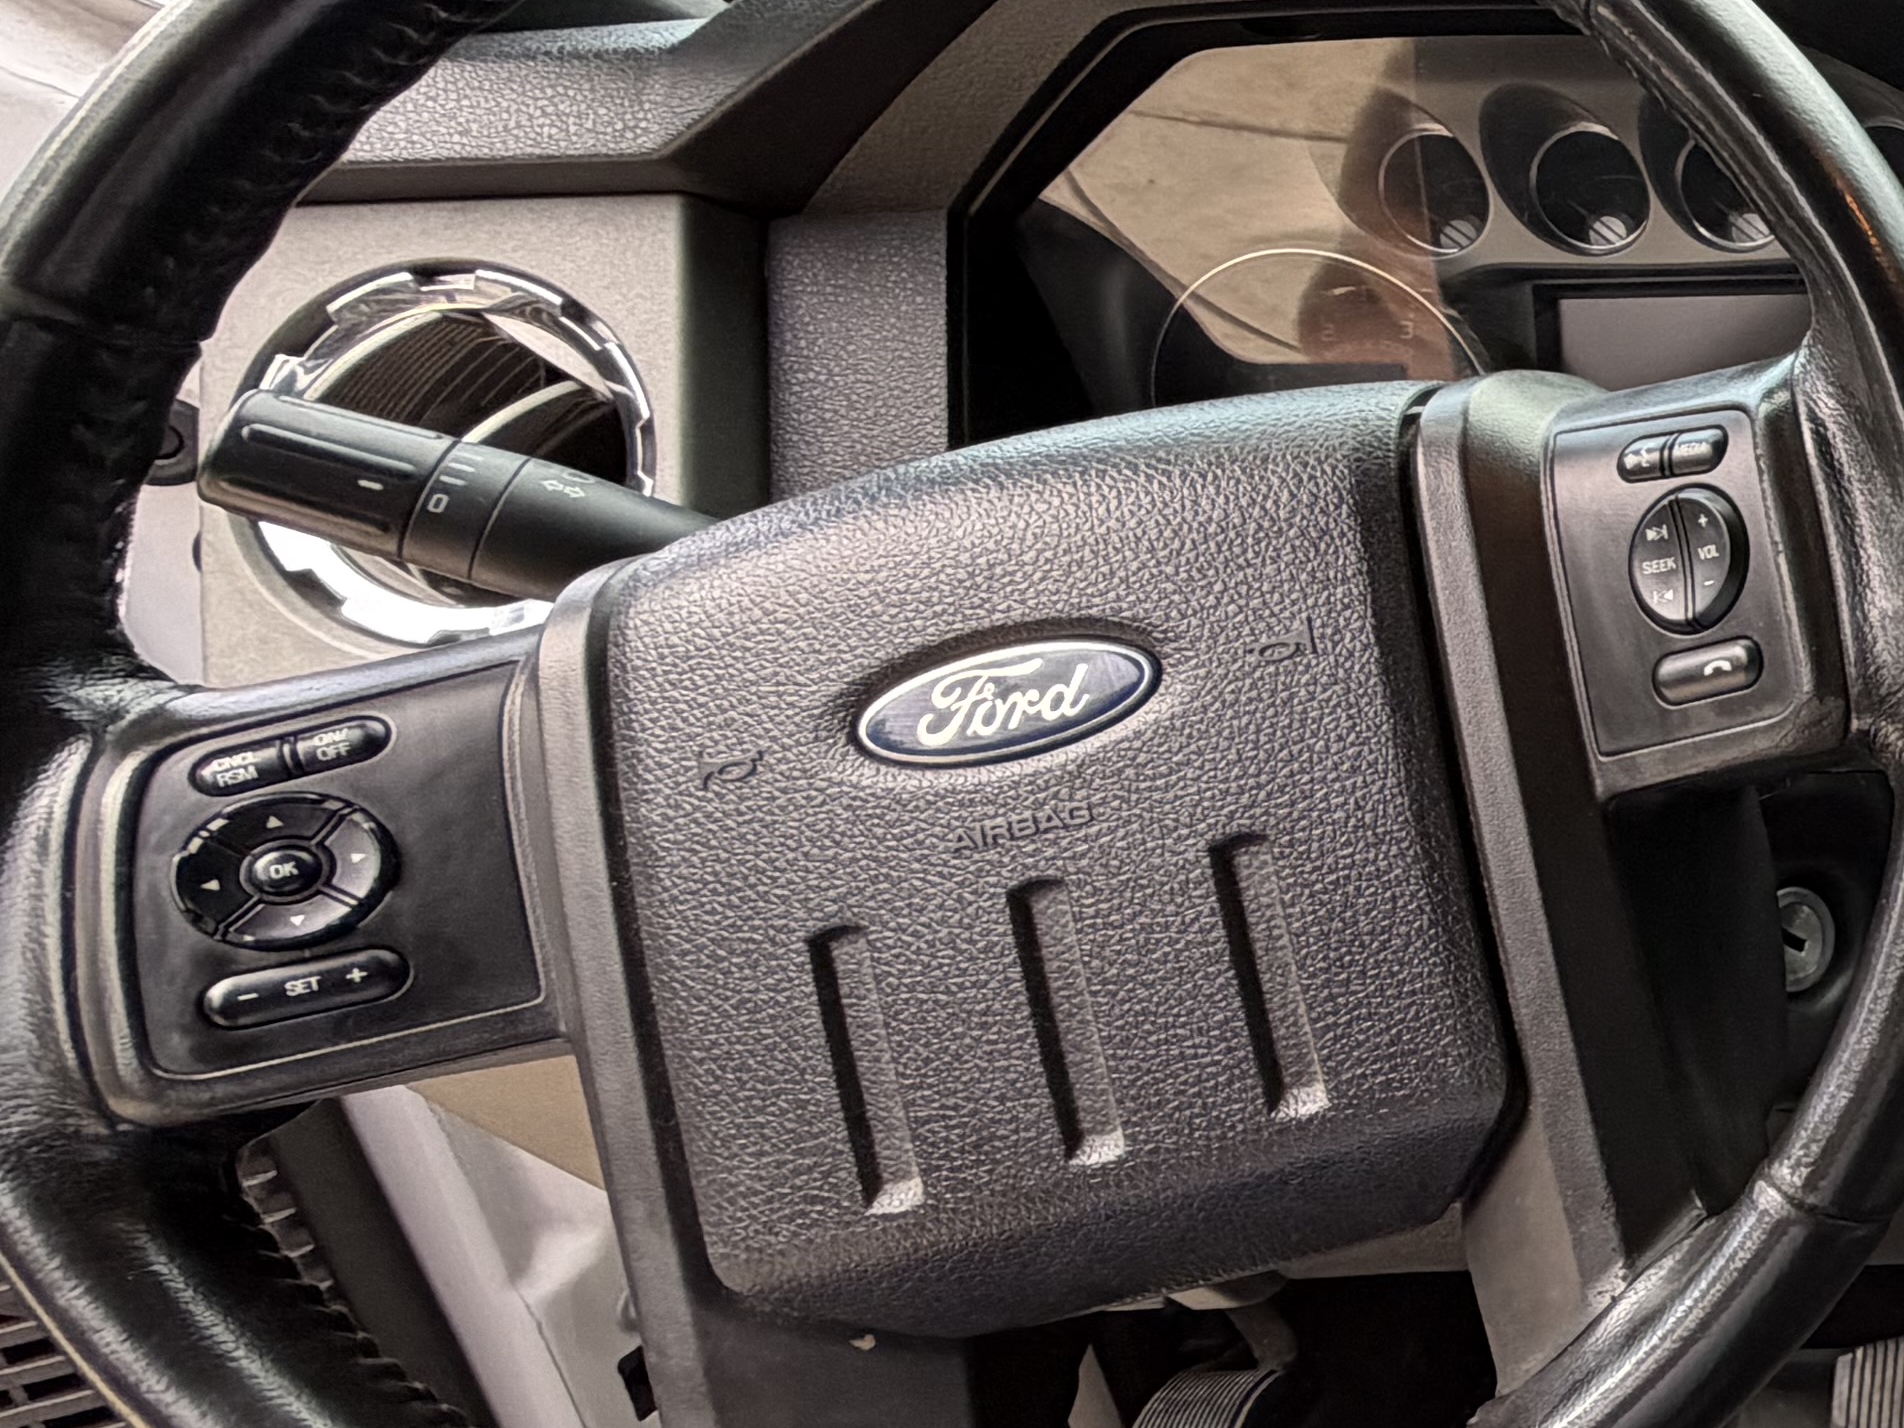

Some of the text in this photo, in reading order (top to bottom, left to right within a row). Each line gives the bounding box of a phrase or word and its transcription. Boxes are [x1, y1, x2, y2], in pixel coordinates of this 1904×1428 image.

[1399, 320, 1415, 340] 3
[1697, 544, 1720, 561] VOL
[1641, 556, 1677, 575] SEEK
[916, 658, 1090, 748] Ford
[315, 741, 353, 762] OFF
[215, 765, 260, 788] RSM
[950, 805, 1098, 856] AIRBAG
[268, 860, 299, 879] OK
[283, 974, 321, 997] SET
